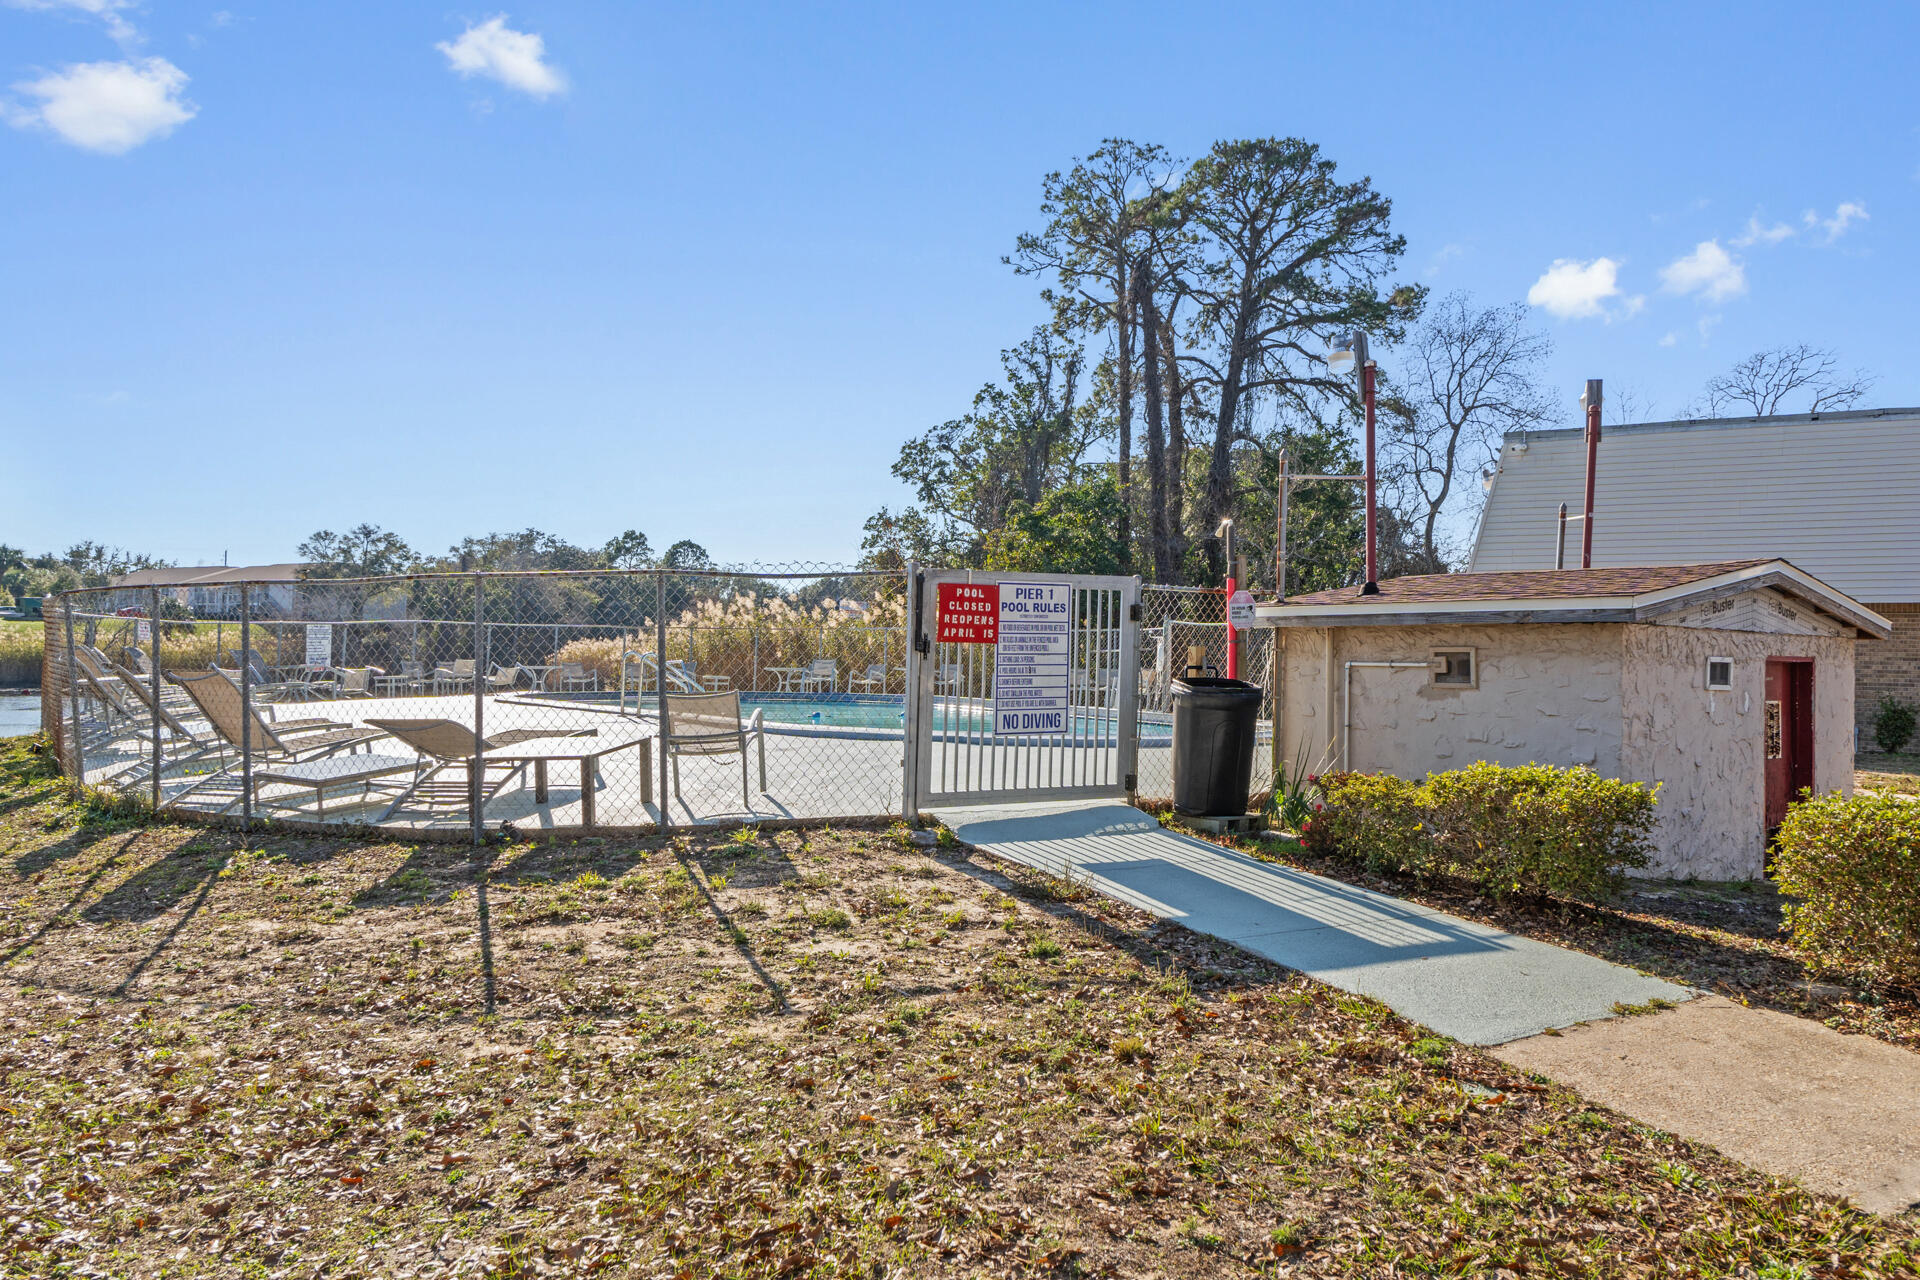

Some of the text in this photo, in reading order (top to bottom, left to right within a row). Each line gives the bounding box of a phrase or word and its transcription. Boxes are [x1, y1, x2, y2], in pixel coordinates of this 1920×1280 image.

[956, 588, 985, 598] POOL
[1016, 588, 1054, 600] PIER 1
[949, 601, 991, 611] CLOSED
[1001, 602, 1066, 613] POOL RULES
[944, 614, 994, 625] REOPENS
[943, 628, 994, 638] APRIL 15
[1002, 712, 1061, 729] NO DIVING
